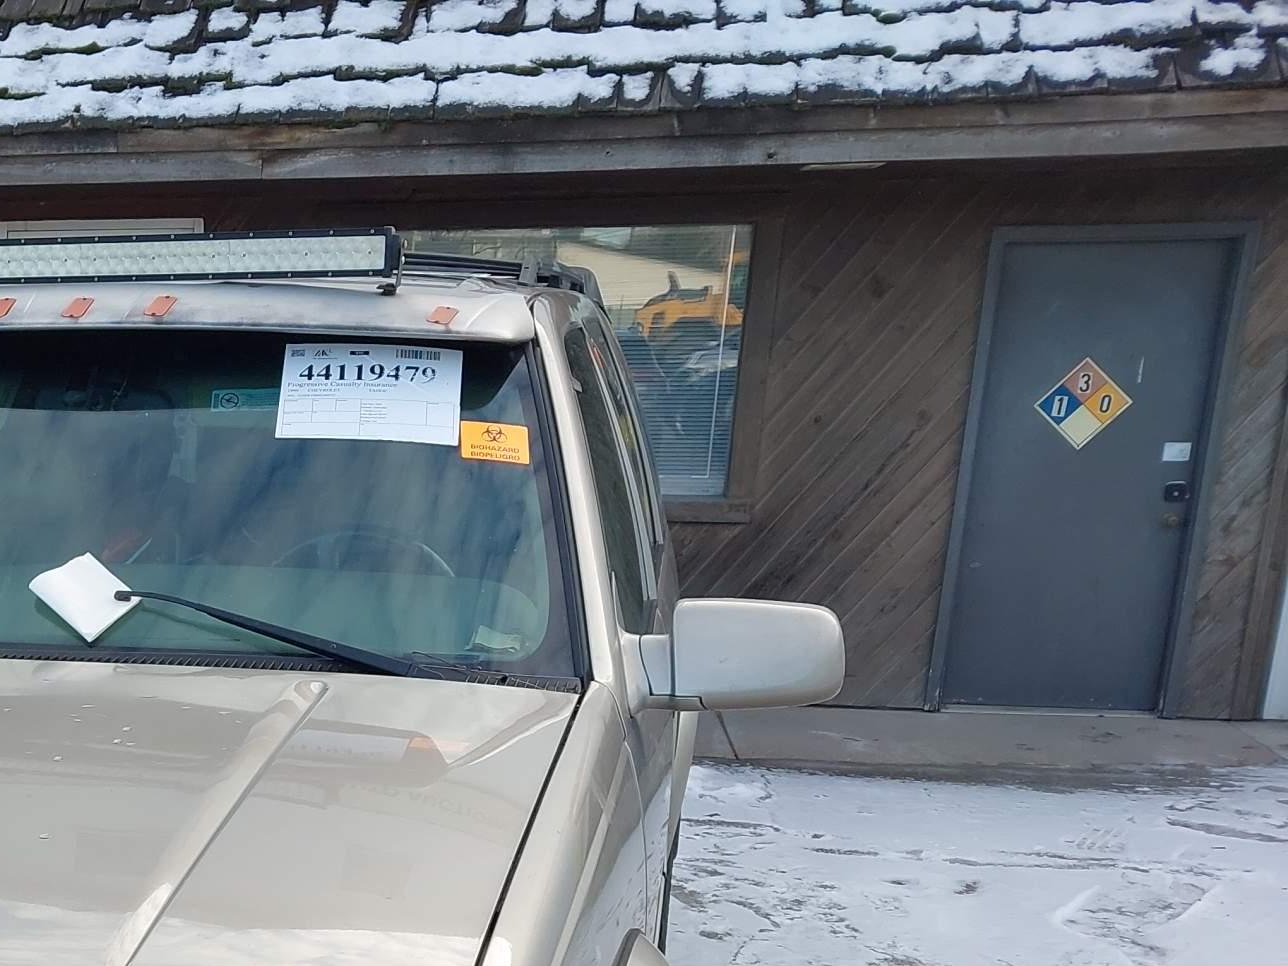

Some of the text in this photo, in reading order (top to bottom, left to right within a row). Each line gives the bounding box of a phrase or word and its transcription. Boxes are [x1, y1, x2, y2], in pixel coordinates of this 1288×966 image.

[299, 363, 437, 383] 44119479
[1079, 374, 1091, 392] 3
[1056, 394, 1112, 416] 1 0
[470, 443, 520, 454] BIOHAZARD
[470, 451, 521, 461] BIOPELIGRO
